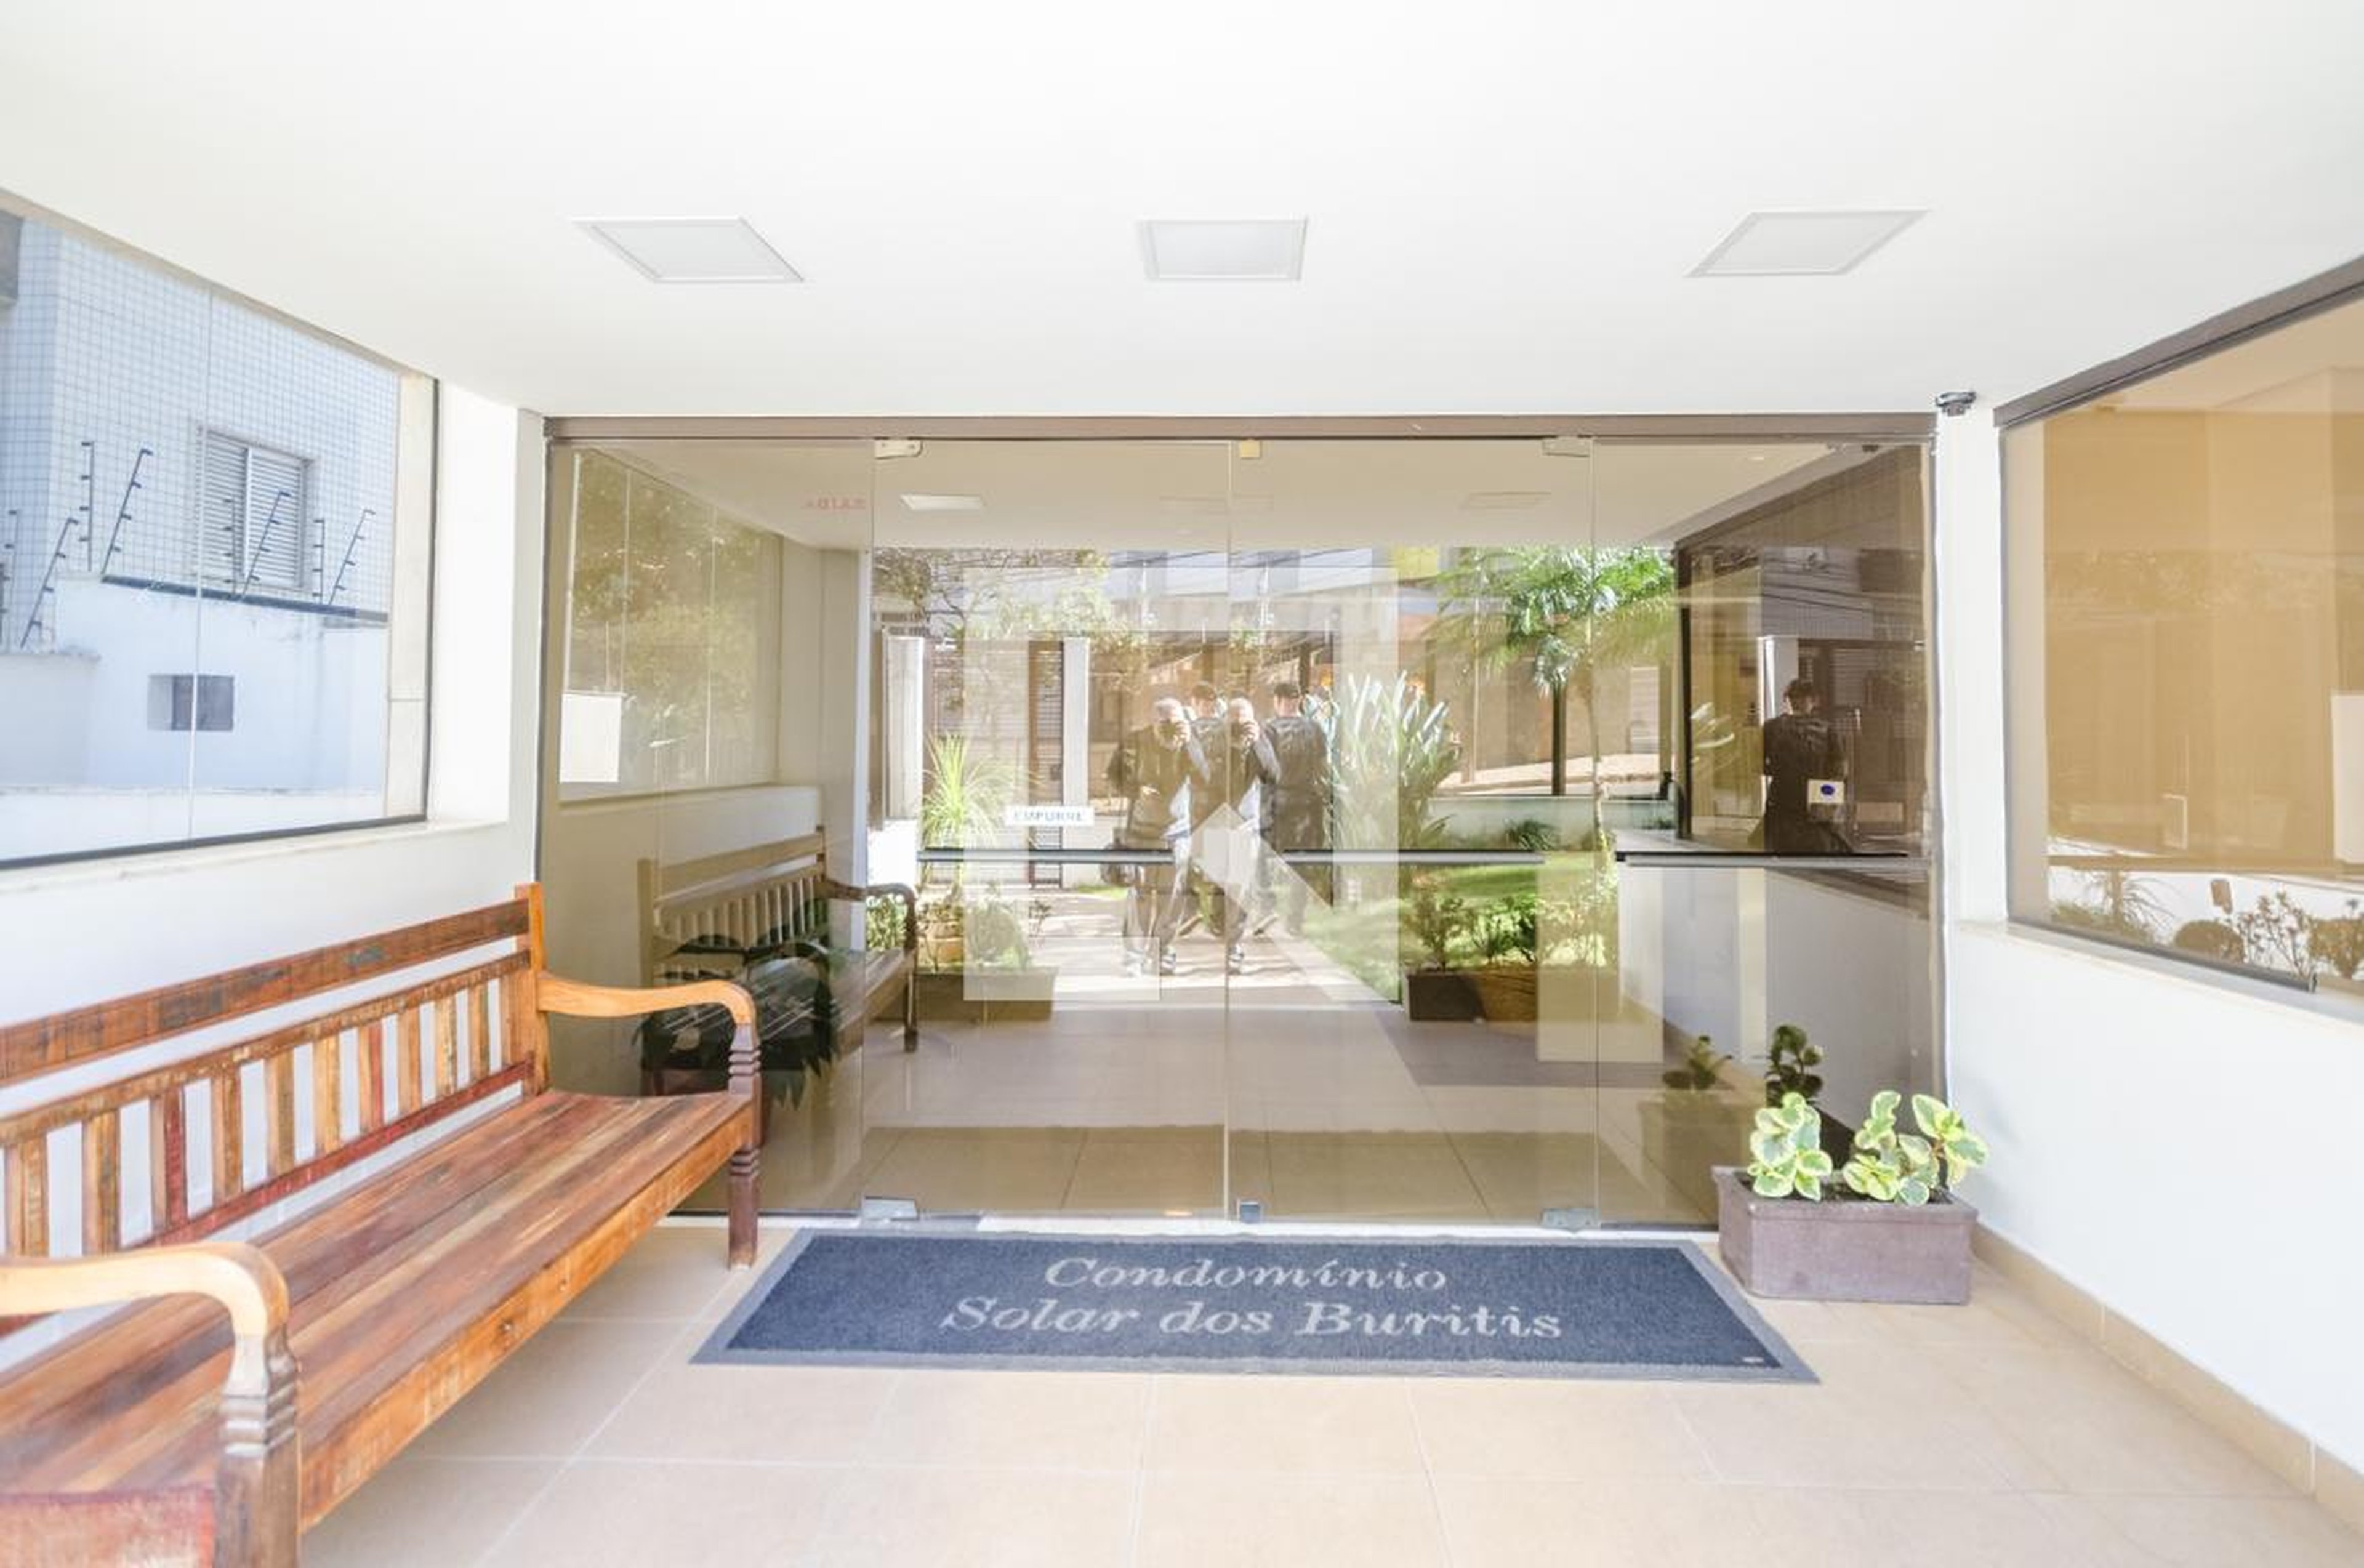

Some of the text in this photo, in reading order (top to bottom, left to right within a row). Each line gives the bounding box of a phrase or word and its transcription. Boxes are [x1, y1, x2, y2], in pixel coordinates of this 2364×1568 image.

[1045, 1258, 1447, 1290] Condomínio
[939, 1295, 1562, 1338] Solar dos Buritis
